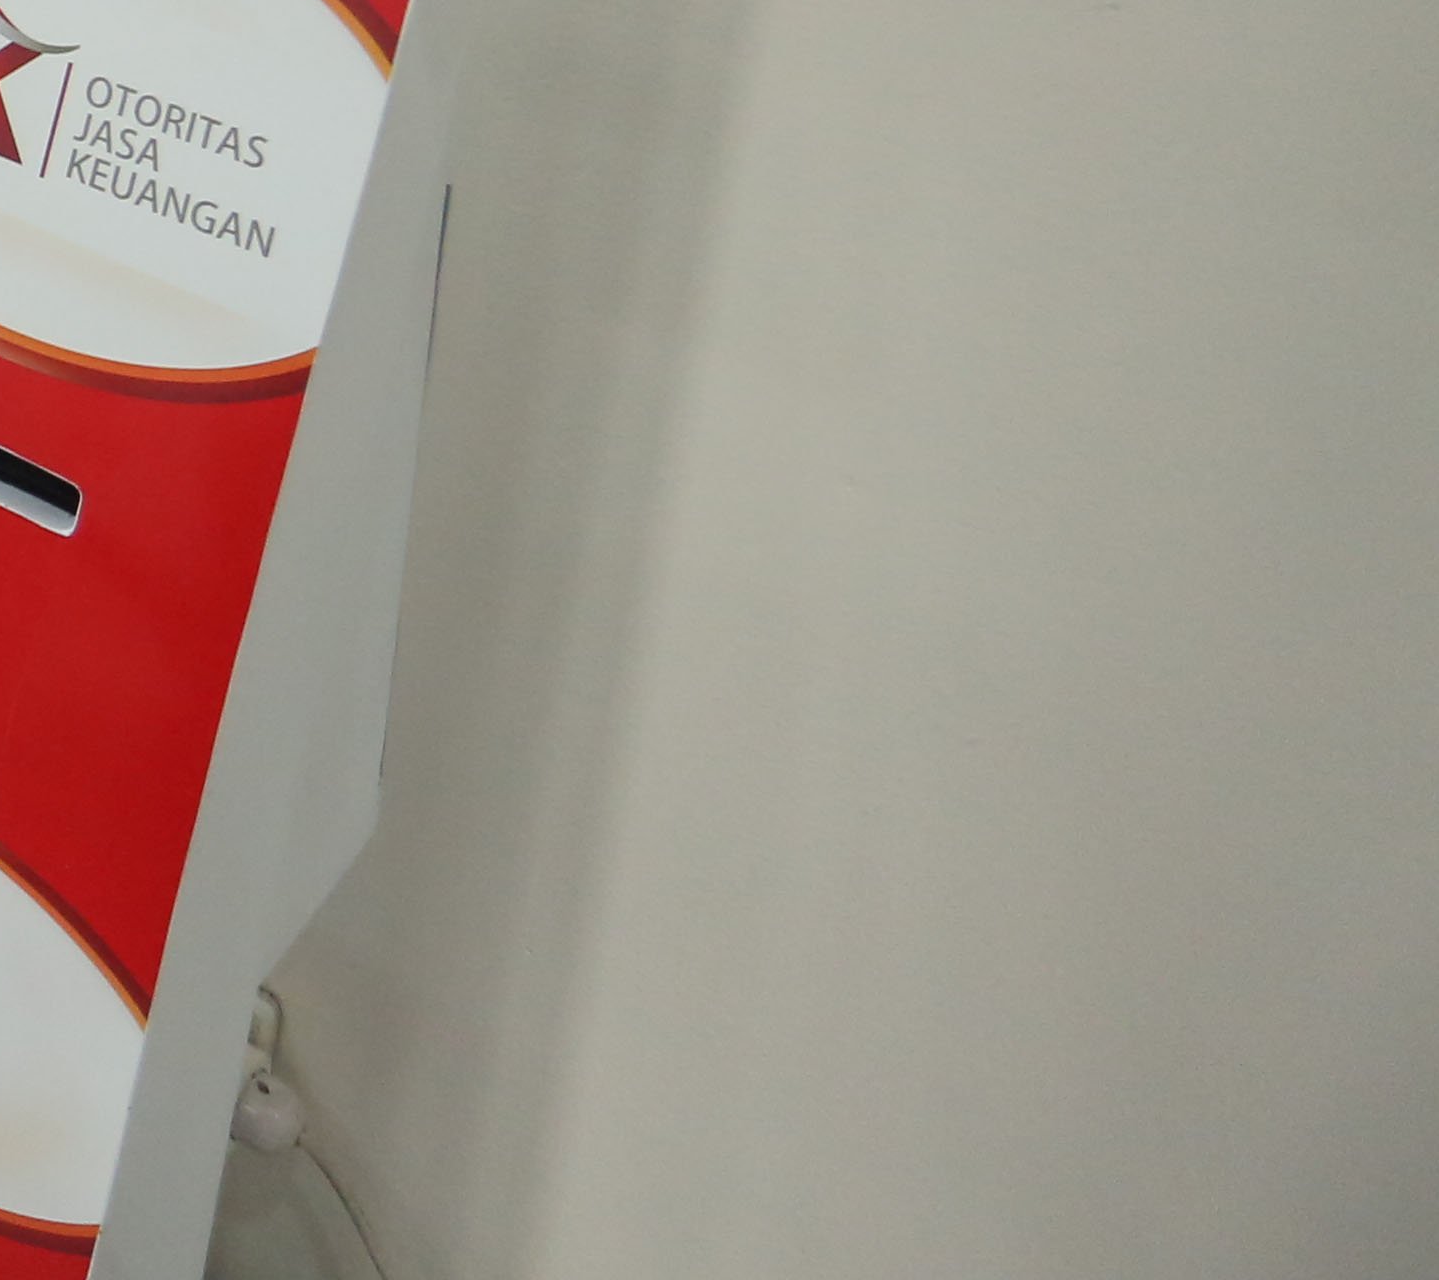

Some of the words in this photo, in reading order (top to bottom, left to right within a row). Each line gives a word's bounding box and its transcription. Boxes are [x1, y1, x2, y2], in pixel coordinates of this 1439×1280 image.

[73, 113, 160, 172] JASA
[86, 77, 269, 169] OTORITAS
[66, 148, 277, 258] KEUANGAN
